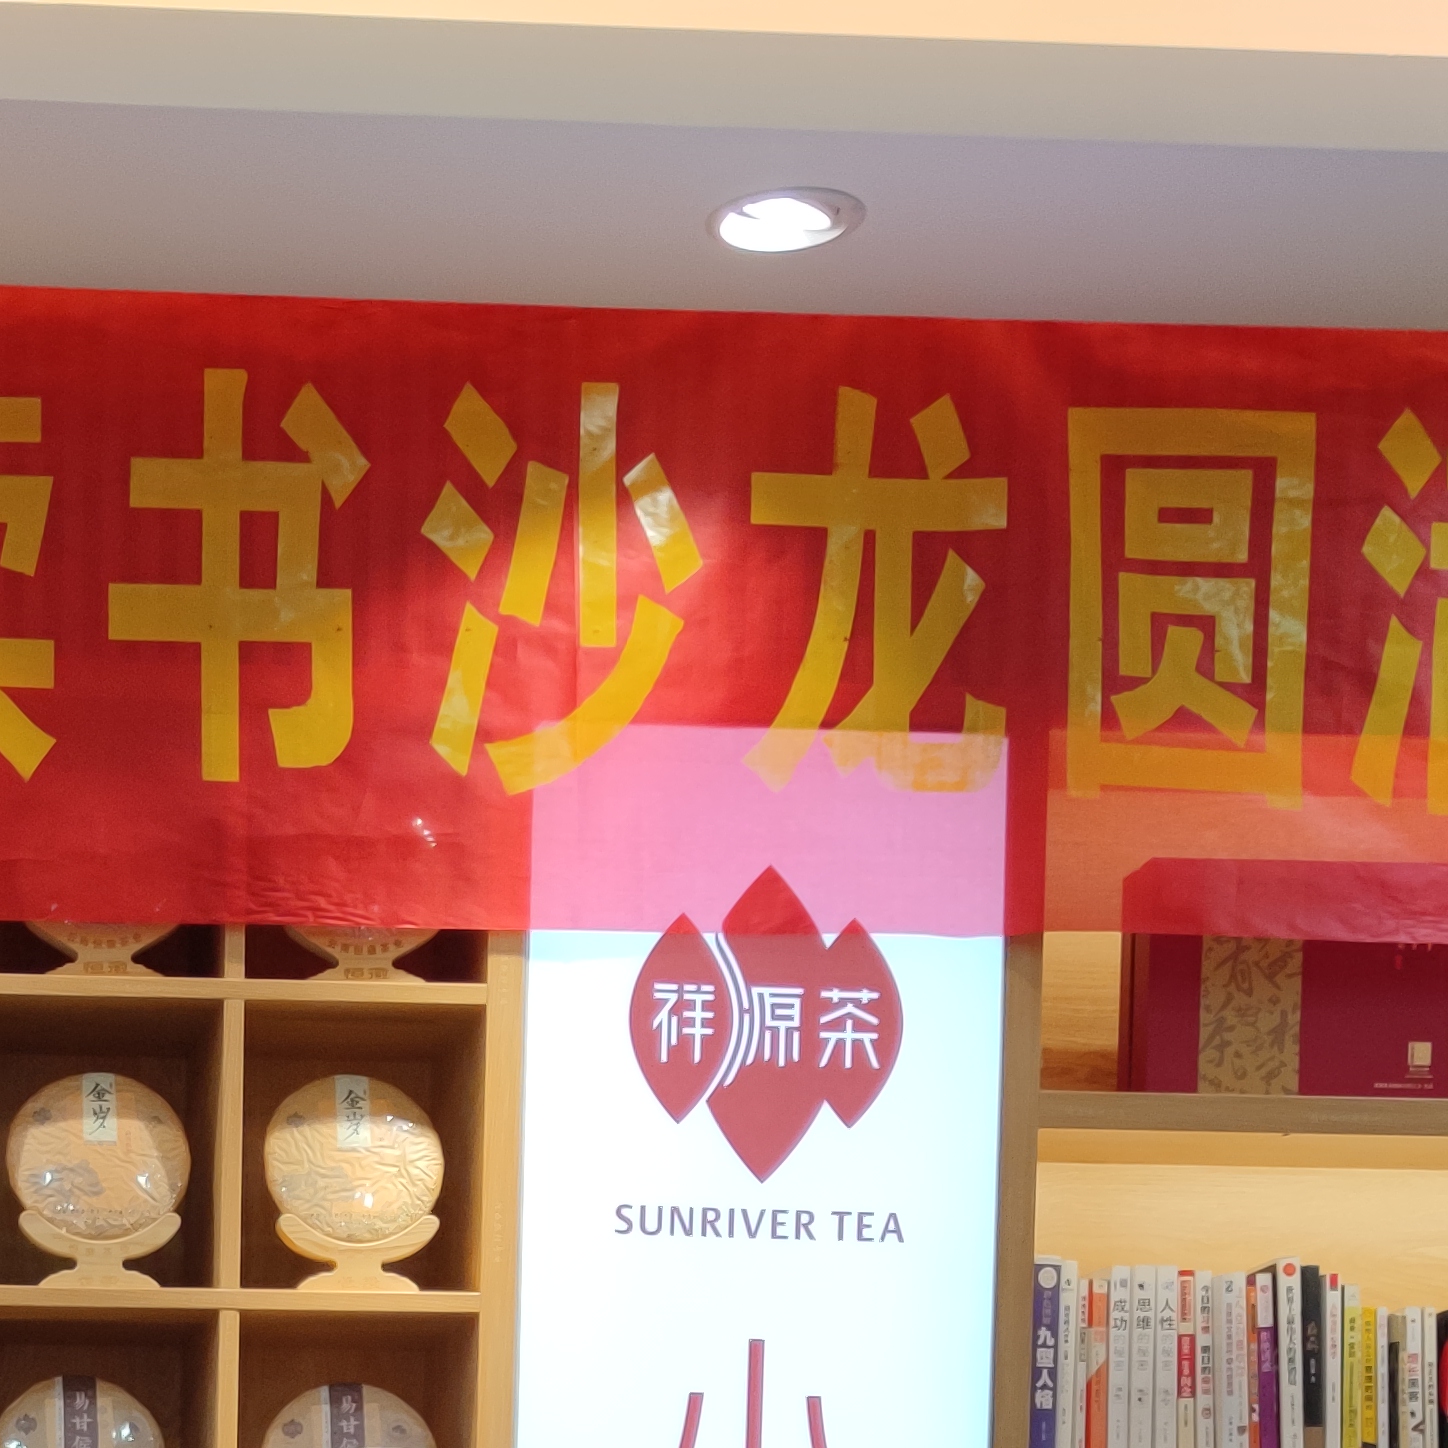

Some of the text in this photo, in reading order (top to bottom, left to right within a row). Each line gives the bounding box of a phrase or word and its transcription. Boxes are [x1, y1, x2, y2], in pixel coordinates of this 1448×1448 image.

[651, 981, 881, 1080] 祥源茶
[614, 1203, 906, 1243] SUNRIVER TEA
